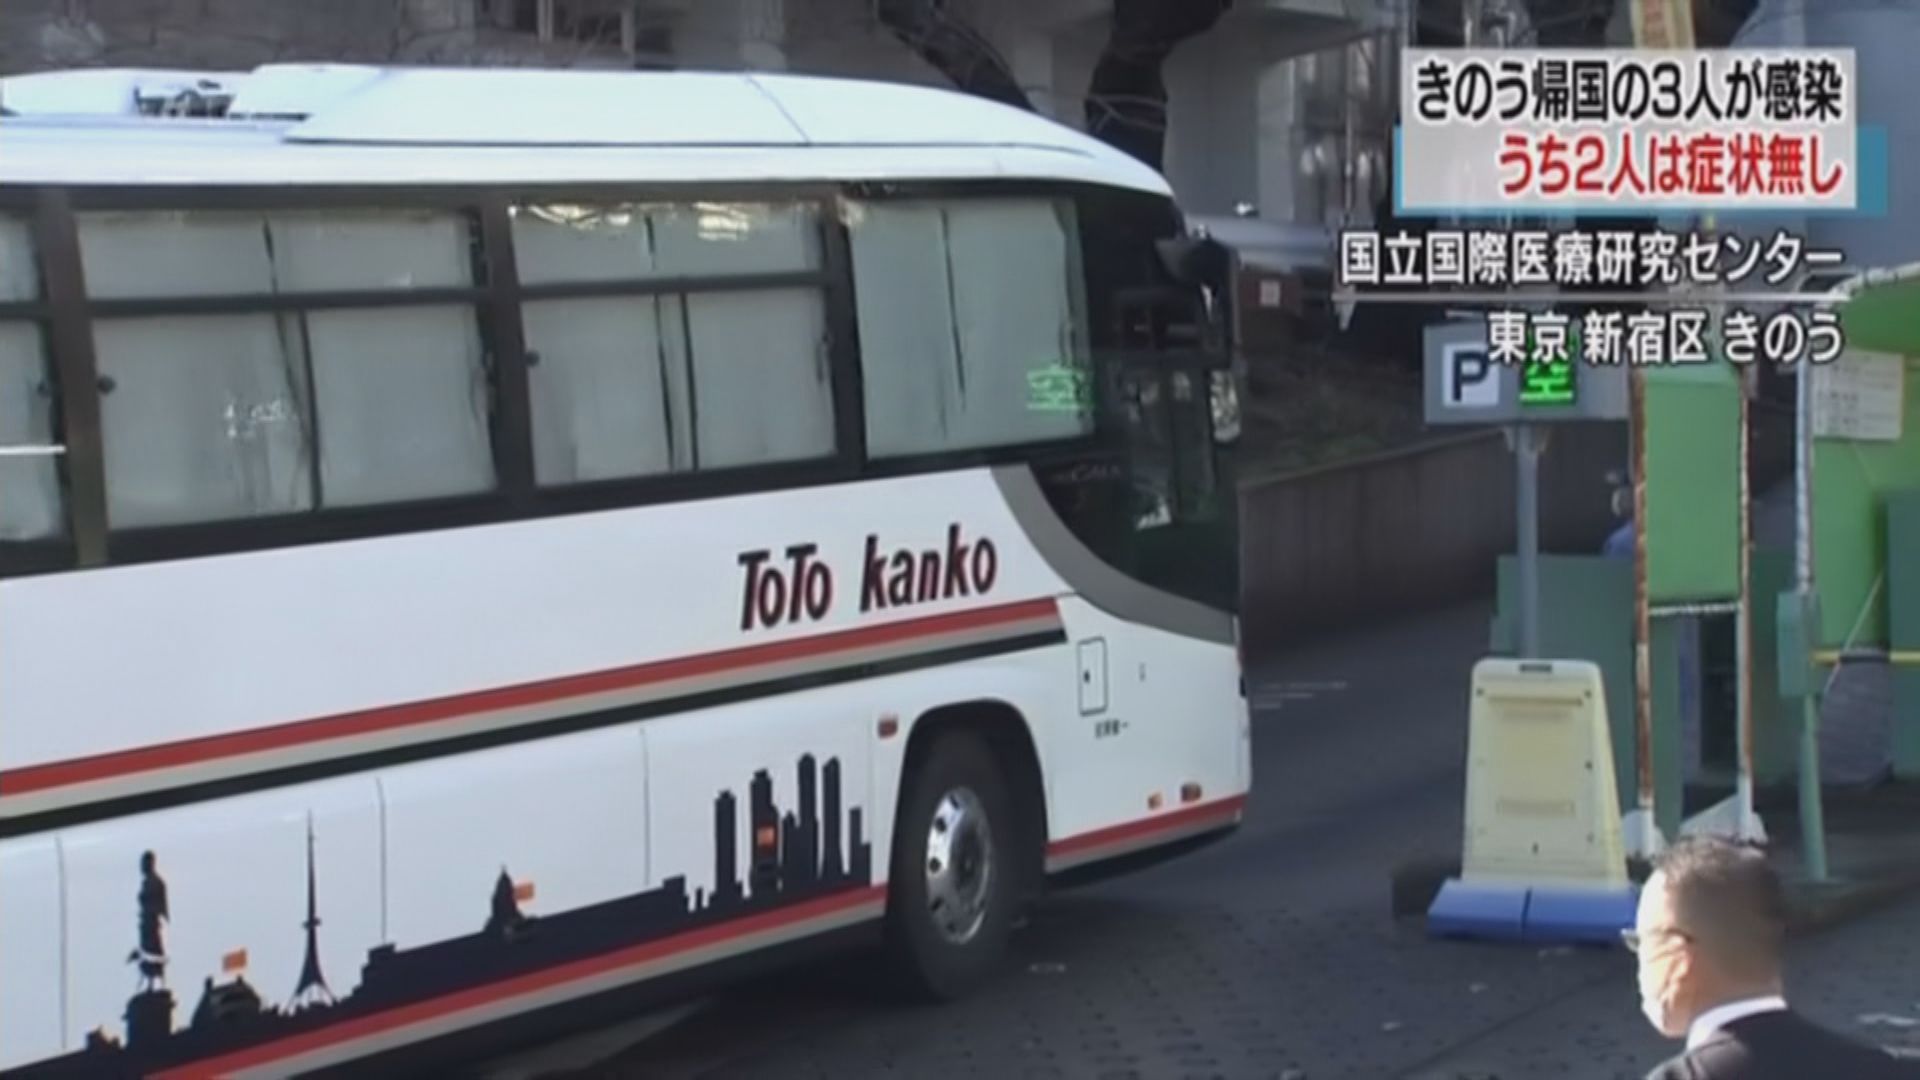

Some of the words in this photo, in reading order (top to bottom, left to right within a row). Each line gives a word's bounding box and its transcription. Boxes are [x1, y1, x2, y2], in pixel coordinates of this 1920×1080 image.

[1453, 350, 1489, 402] P
[738, 543, 833, 631] ToTo
[859, 523, 998, 613] kanko
